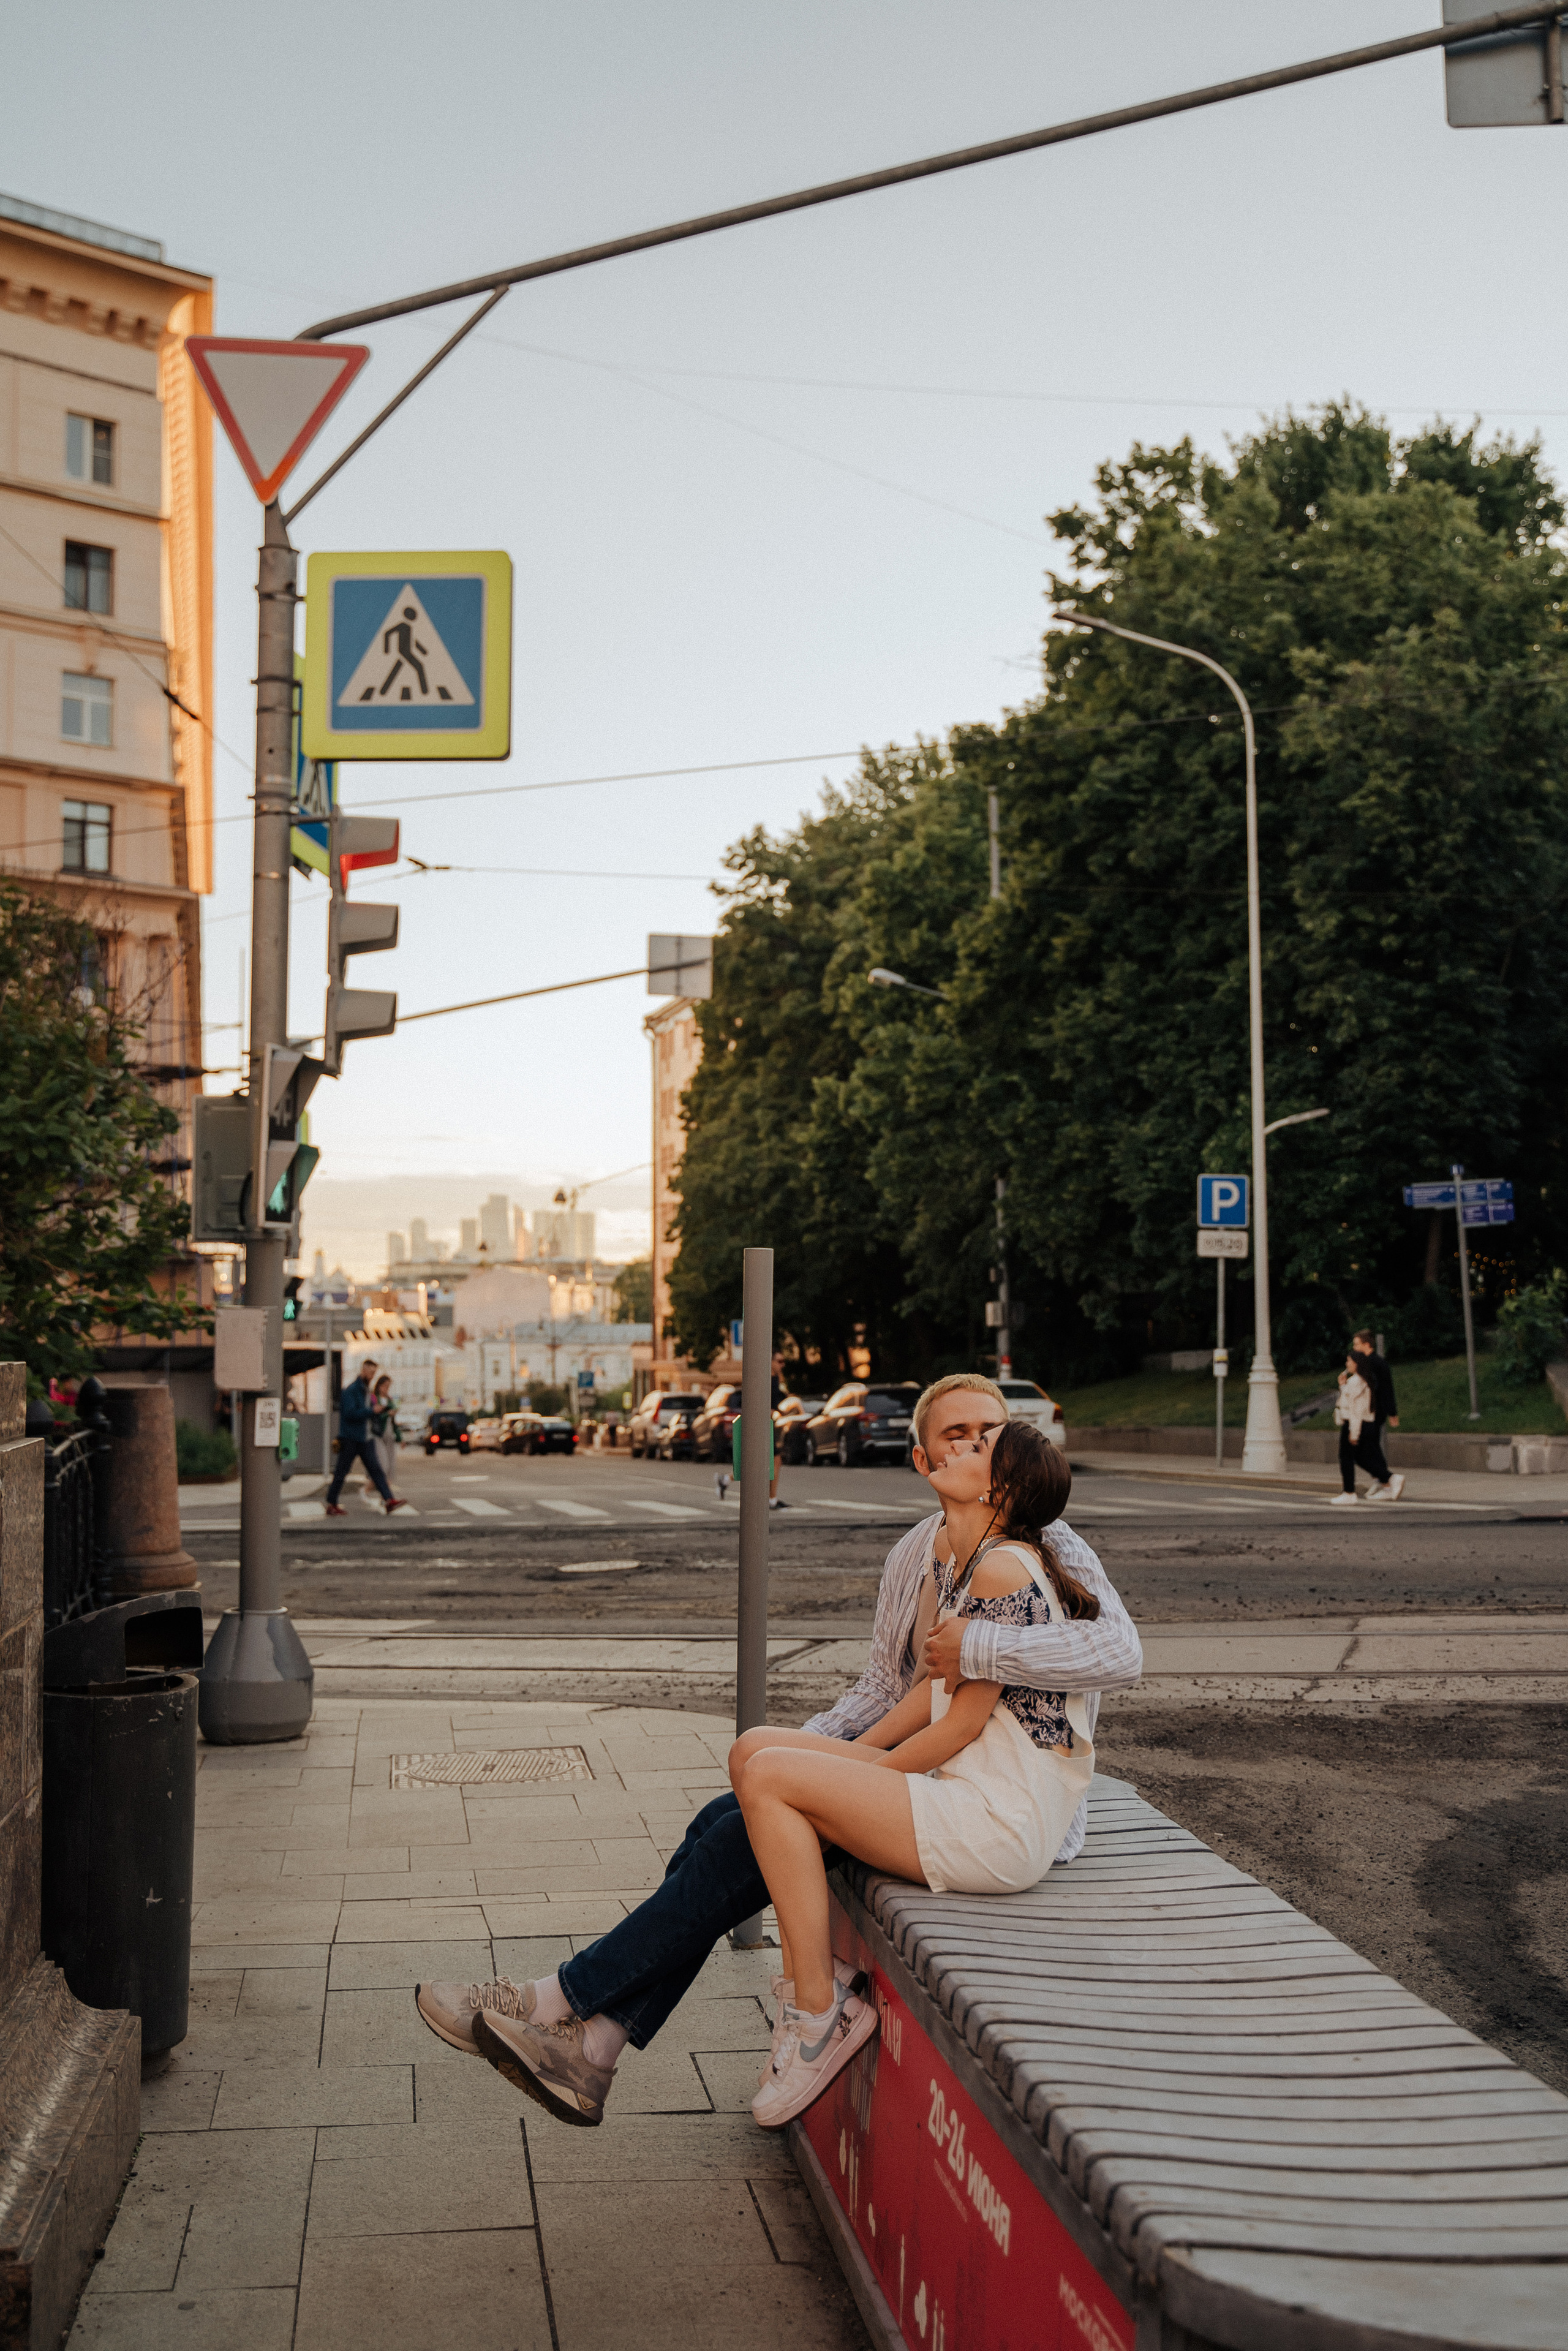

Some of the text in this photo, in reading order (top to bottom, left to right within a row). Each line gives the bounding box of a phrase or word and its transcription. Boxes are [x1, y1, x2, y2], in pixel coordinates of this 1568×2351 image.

[1212, 1180, 1240, 1221] P
[928, 2078, 965, 2181] 20-26
[967, 2151, 1011, 2257] ИЮНЯ
